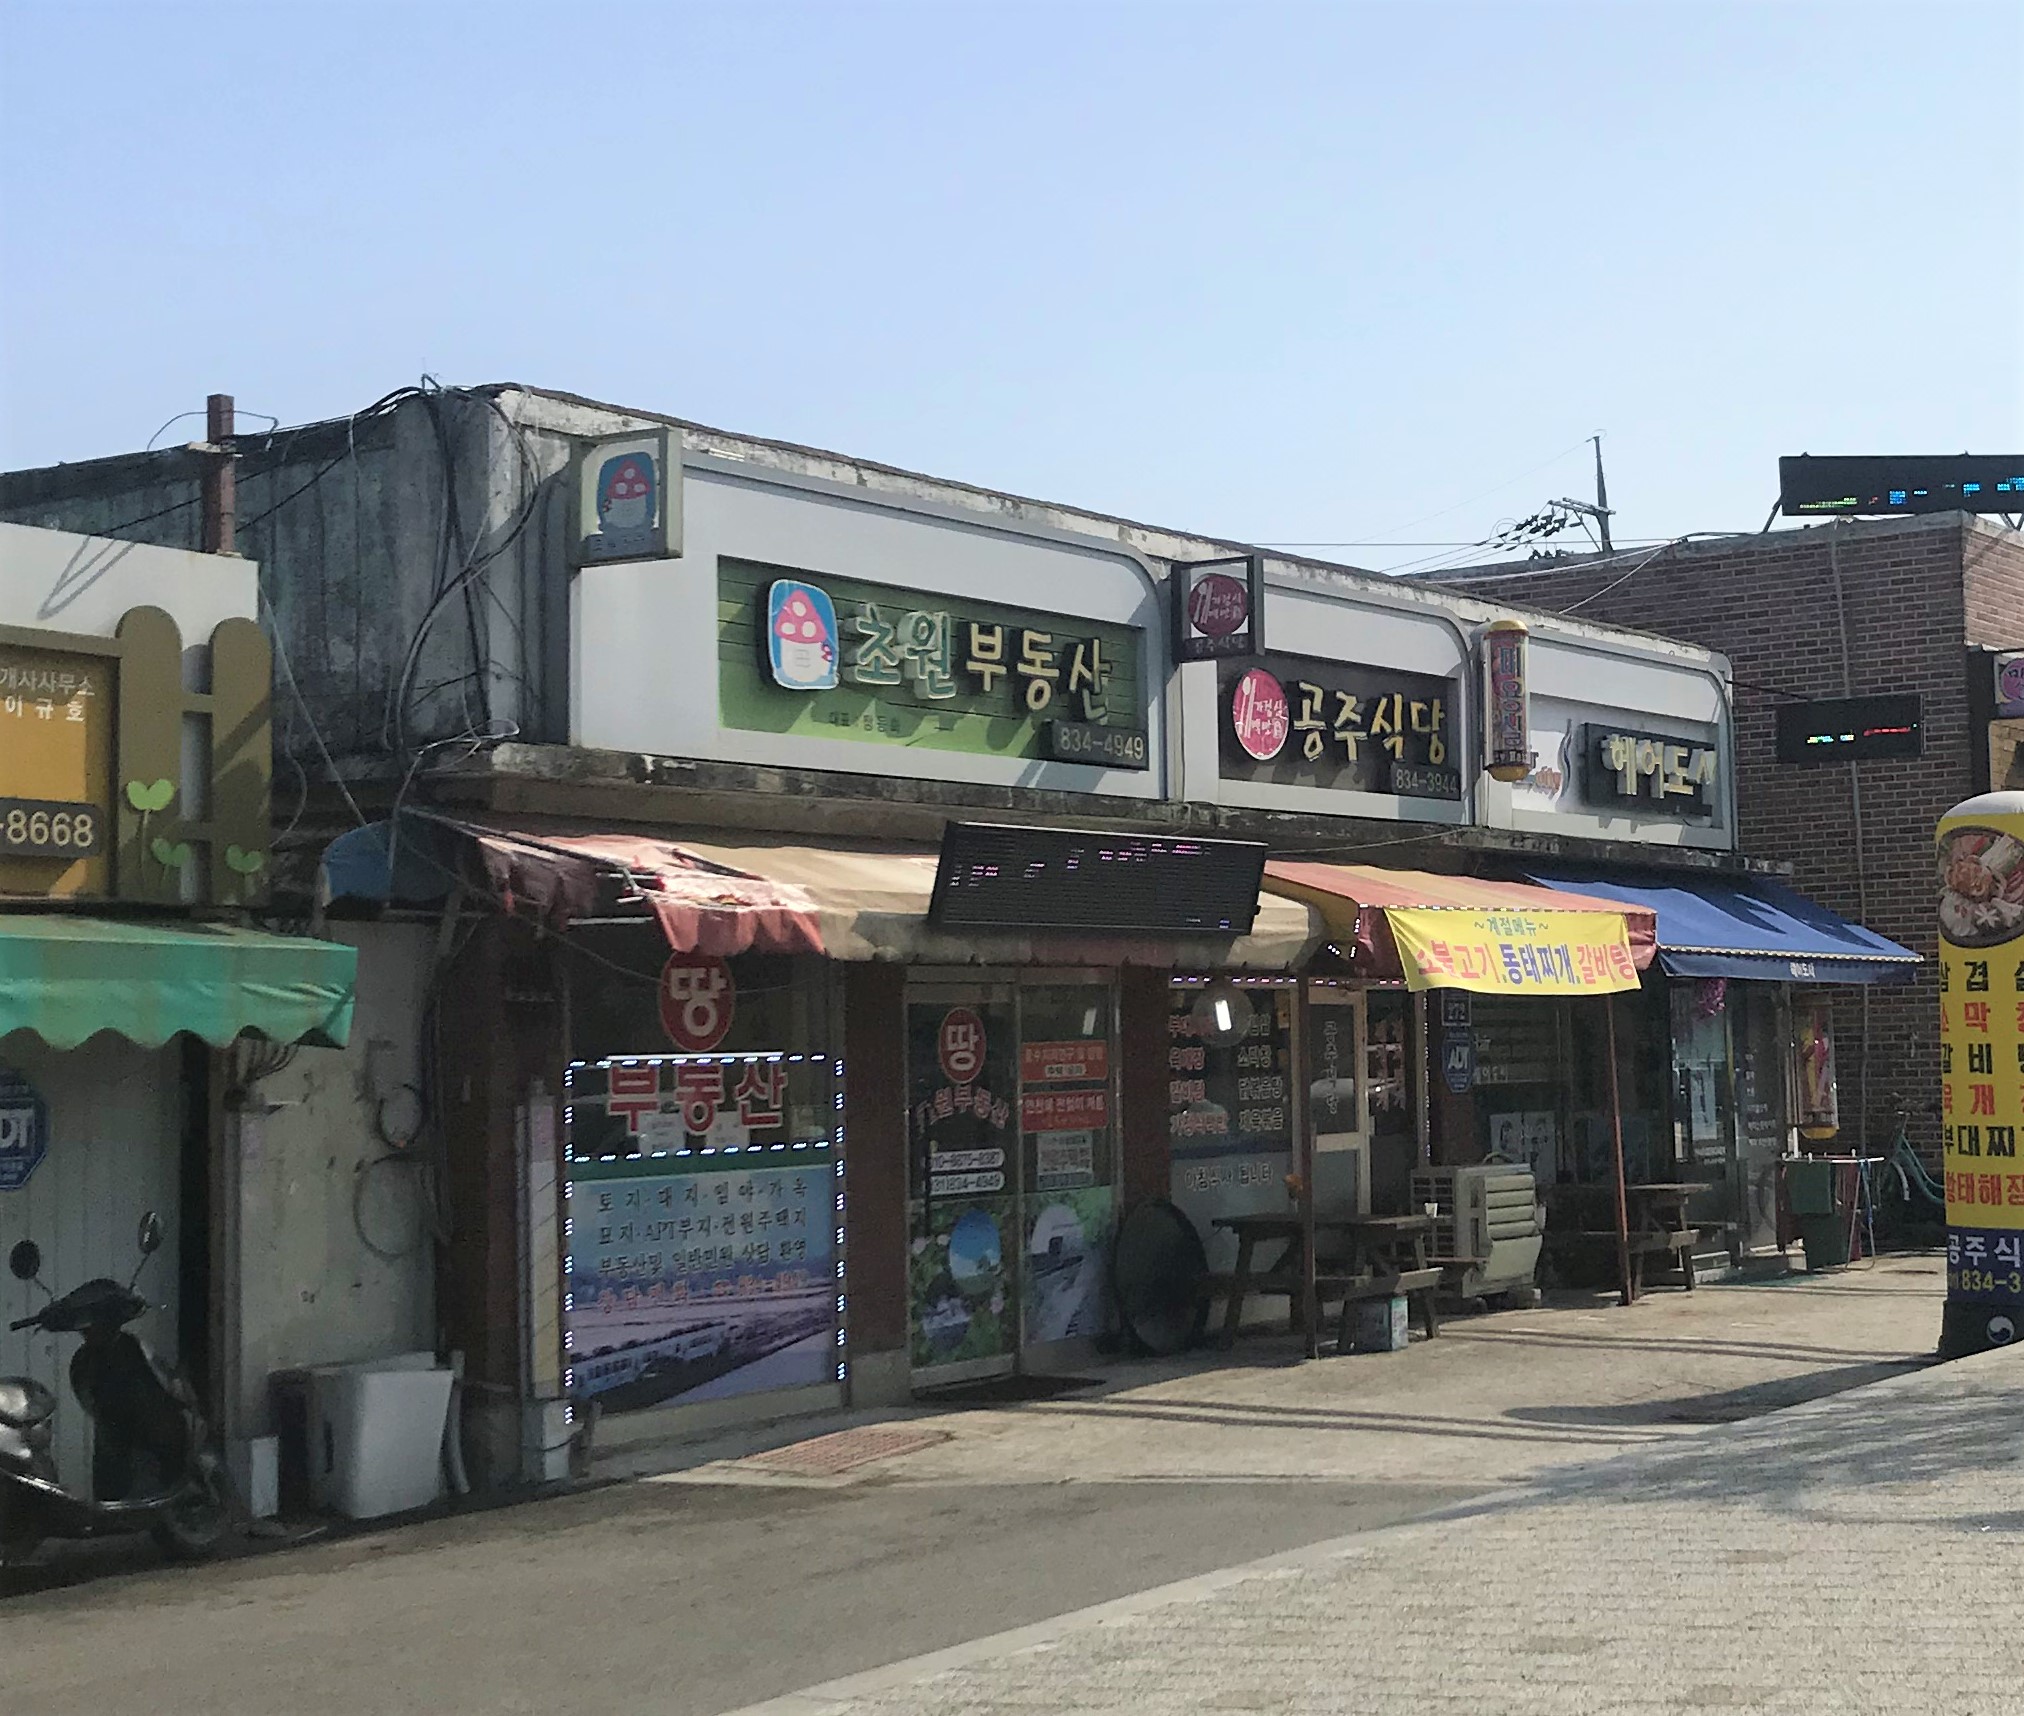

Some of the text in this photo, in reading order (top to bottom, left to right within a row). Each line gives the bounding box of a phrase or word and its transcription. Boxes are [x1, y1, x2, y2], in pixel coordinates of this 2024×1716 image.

[1293, 679, 1446, 766] 공주식당
[1060, 727, 1144, 761] 834-4949
[1395, 768, 1458, 793] 834-3944
[670, 966, 728, 1037] 땅
[947, 1024, 978, 1070] 땅
[1447, 1045, 1470, 1070] ADT
[608, 1062, 789, 1136] 부동산
[1944, 1124, 2024, 1157] 부대찌
